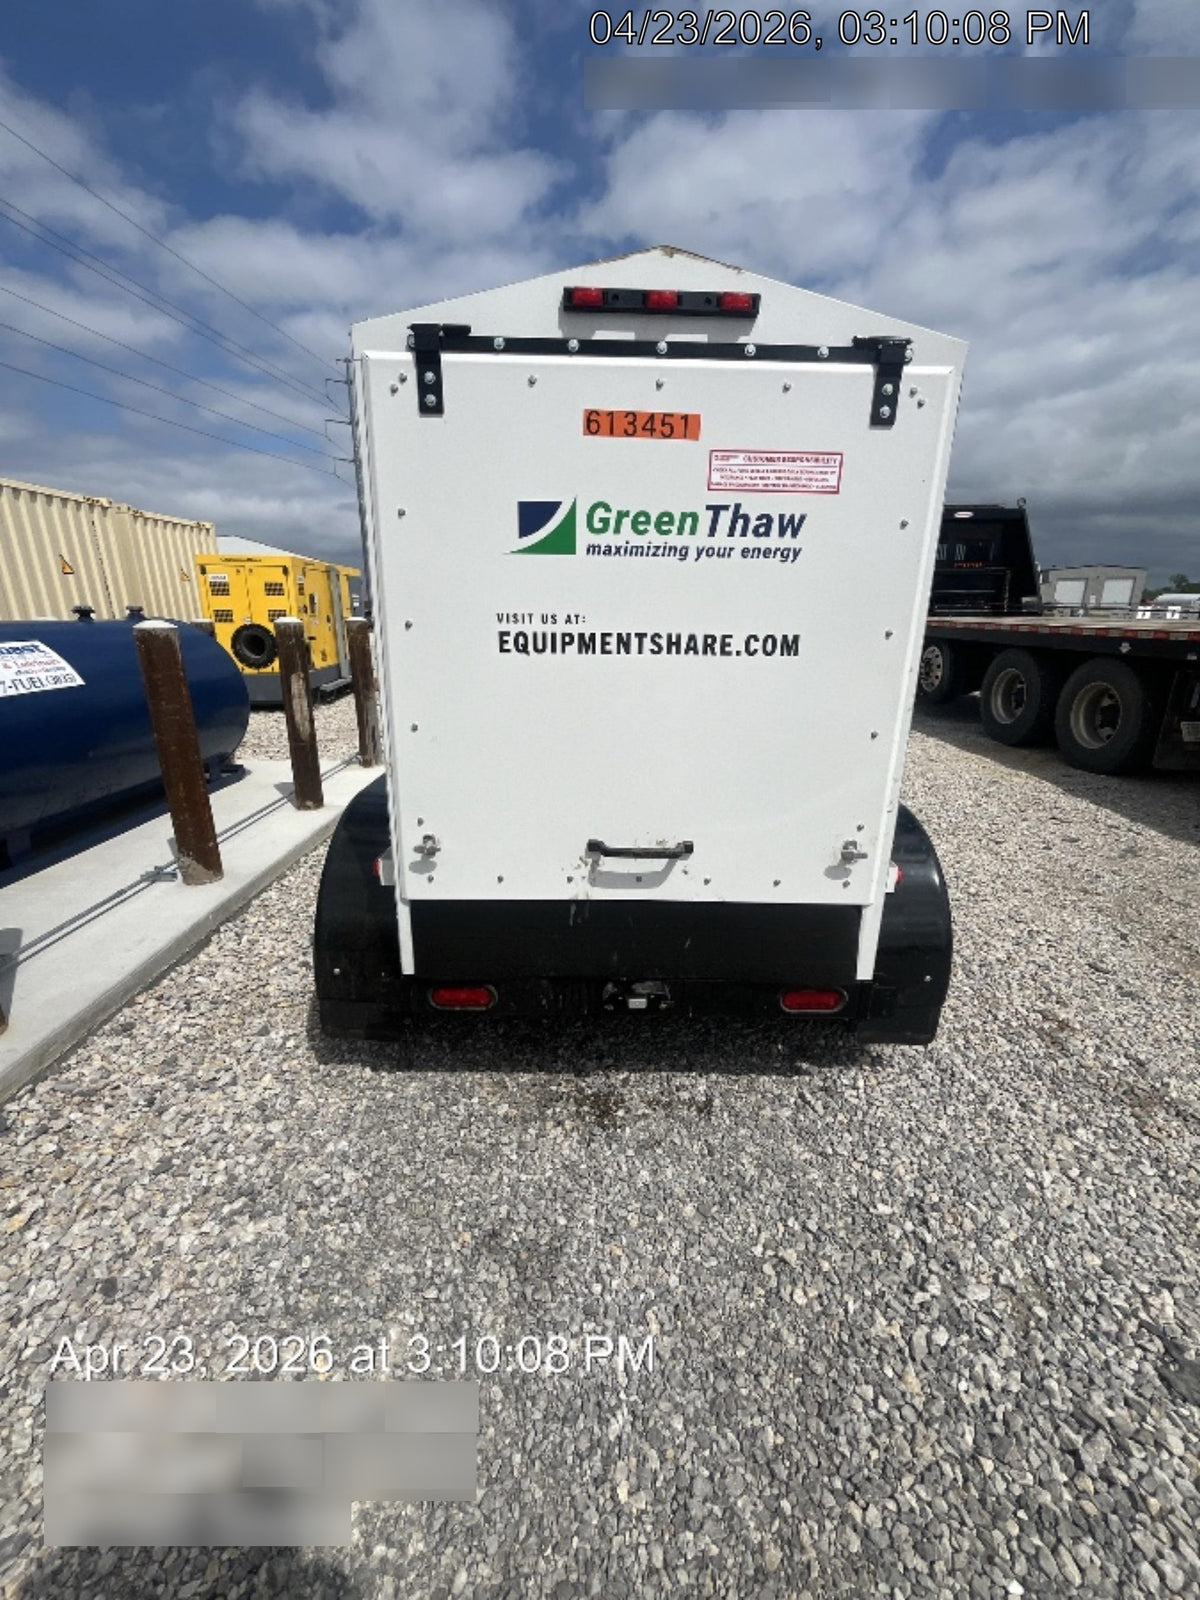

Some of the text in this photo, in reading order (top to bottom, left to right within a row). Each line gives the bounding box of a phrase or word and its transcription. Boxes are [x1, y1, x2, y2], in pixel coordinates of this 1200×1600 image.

[585, 409, 690, 440] 613451
[586, 540, 803, 564] maximizing your energy
[496, 612, 586, 625] VISIT US AT:
[498, 630, 801, 657] EQUIPMENTSHARE.COM
